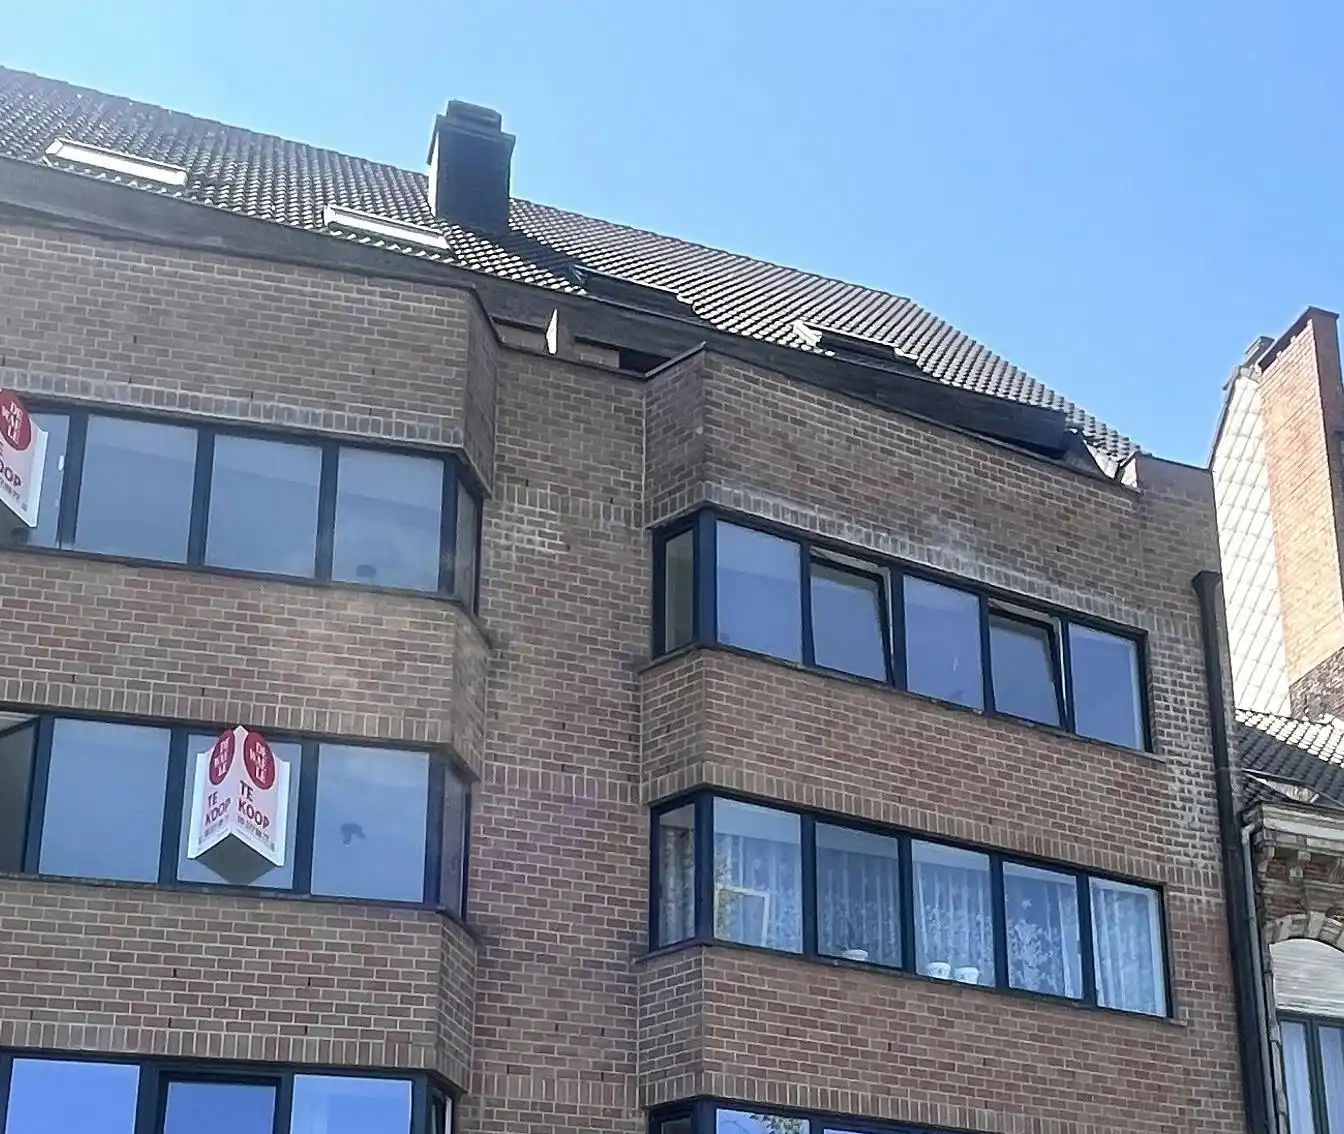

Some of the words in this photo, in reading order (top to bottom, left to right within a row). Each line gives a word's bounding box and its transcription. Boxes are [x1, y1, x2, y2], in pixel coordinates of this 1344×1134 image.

[208, 791, 218, 808] TE
[240, 780, 254, 802] TE
[238, 798, 270, 829] KOOP
